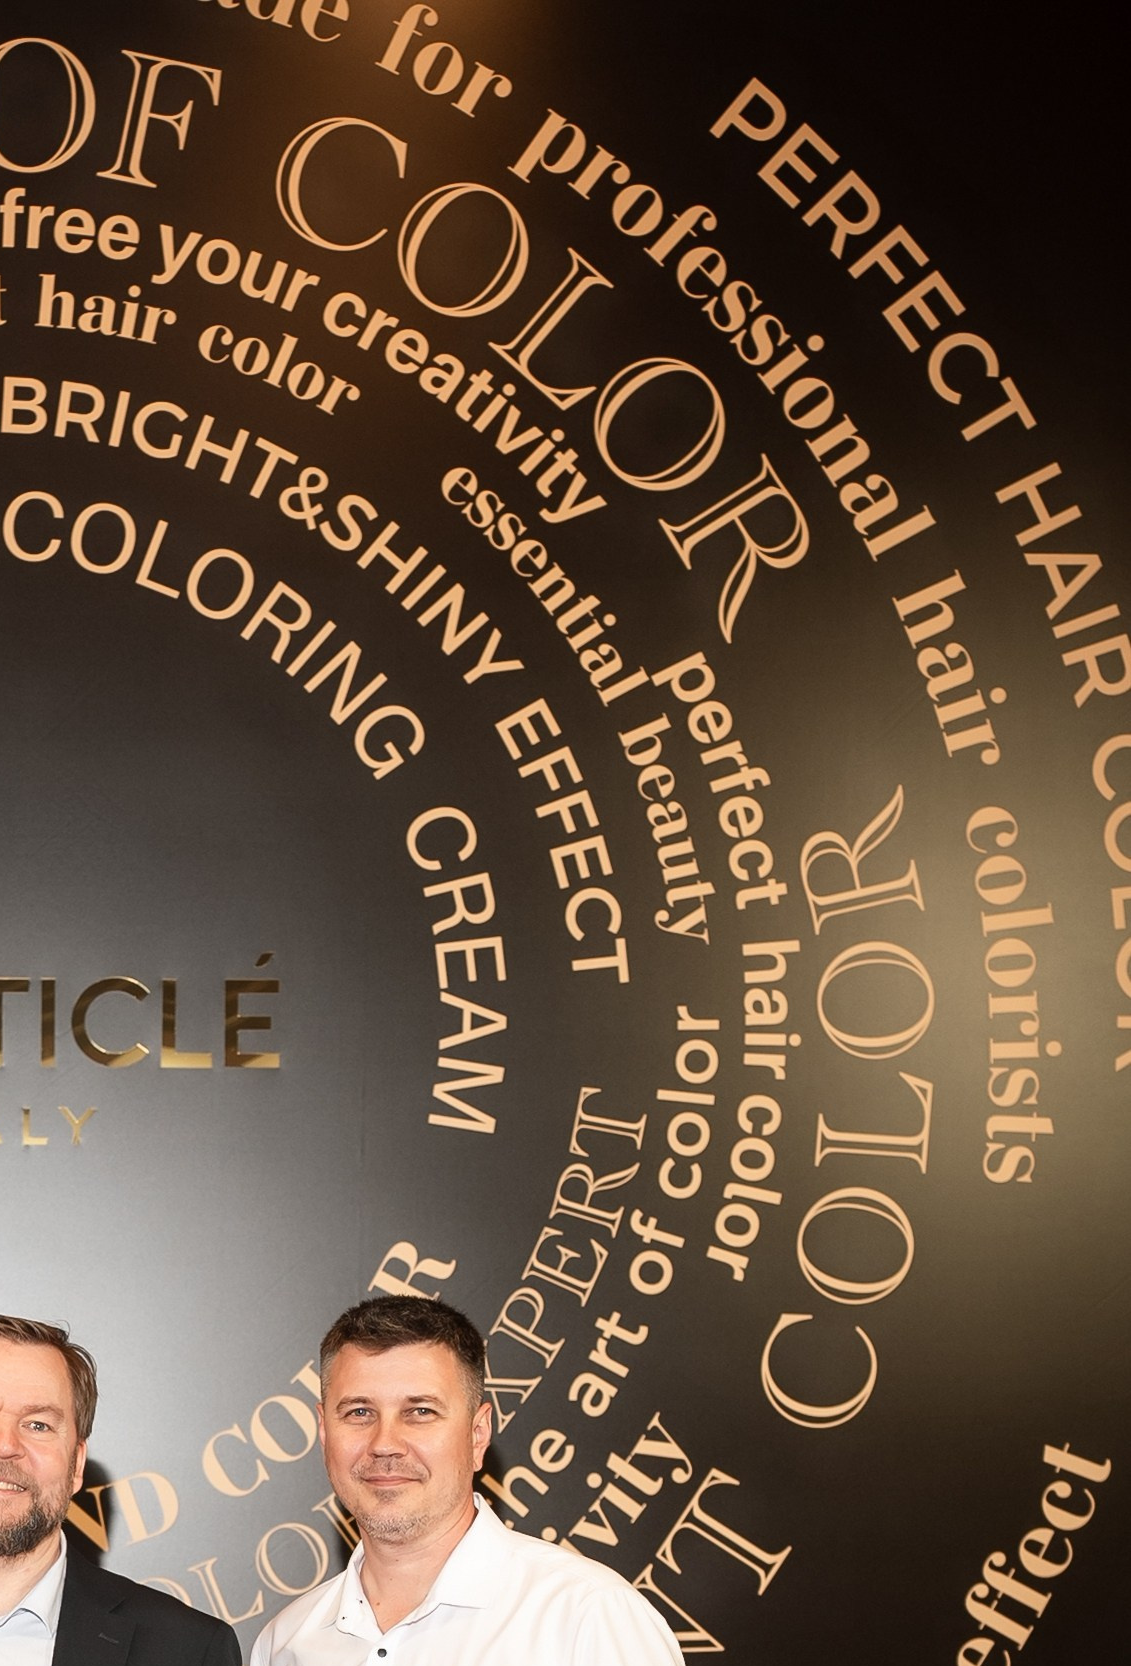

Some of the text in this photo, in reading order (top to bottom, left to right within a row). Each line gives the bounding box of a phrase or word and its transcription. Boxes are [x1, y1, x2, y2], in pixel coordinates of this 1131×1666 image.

[34, 273, 177, 345] hair
[198, 324, 361, 416] color
[150, 223, 321, 312] your
[322, 291, 608, 524] creativity
[275, 116, 810, 645] COLOR
[374, 3, 1062, 1183] for professional hair colorists
[708, 76, 1131, 708] PERFECT HAIR
[0, 375, 525, 685] BRIGHT&SHINY
[494, 697, 630, 984] EFFECT
[2, 490, 426, 781] COLORING
[405, 806, 508, 1134] CREAM
[440, 466, 716, 945] essential beauty
[650, 651, 801, 1282] perfect hair color
[760, 784, 935, 1429] COLOR
[202, 1240, 456, 1497] COR
[481, 1005, 720, 1529] he art of color
[483, 1086, 648, 1433] XPERT
